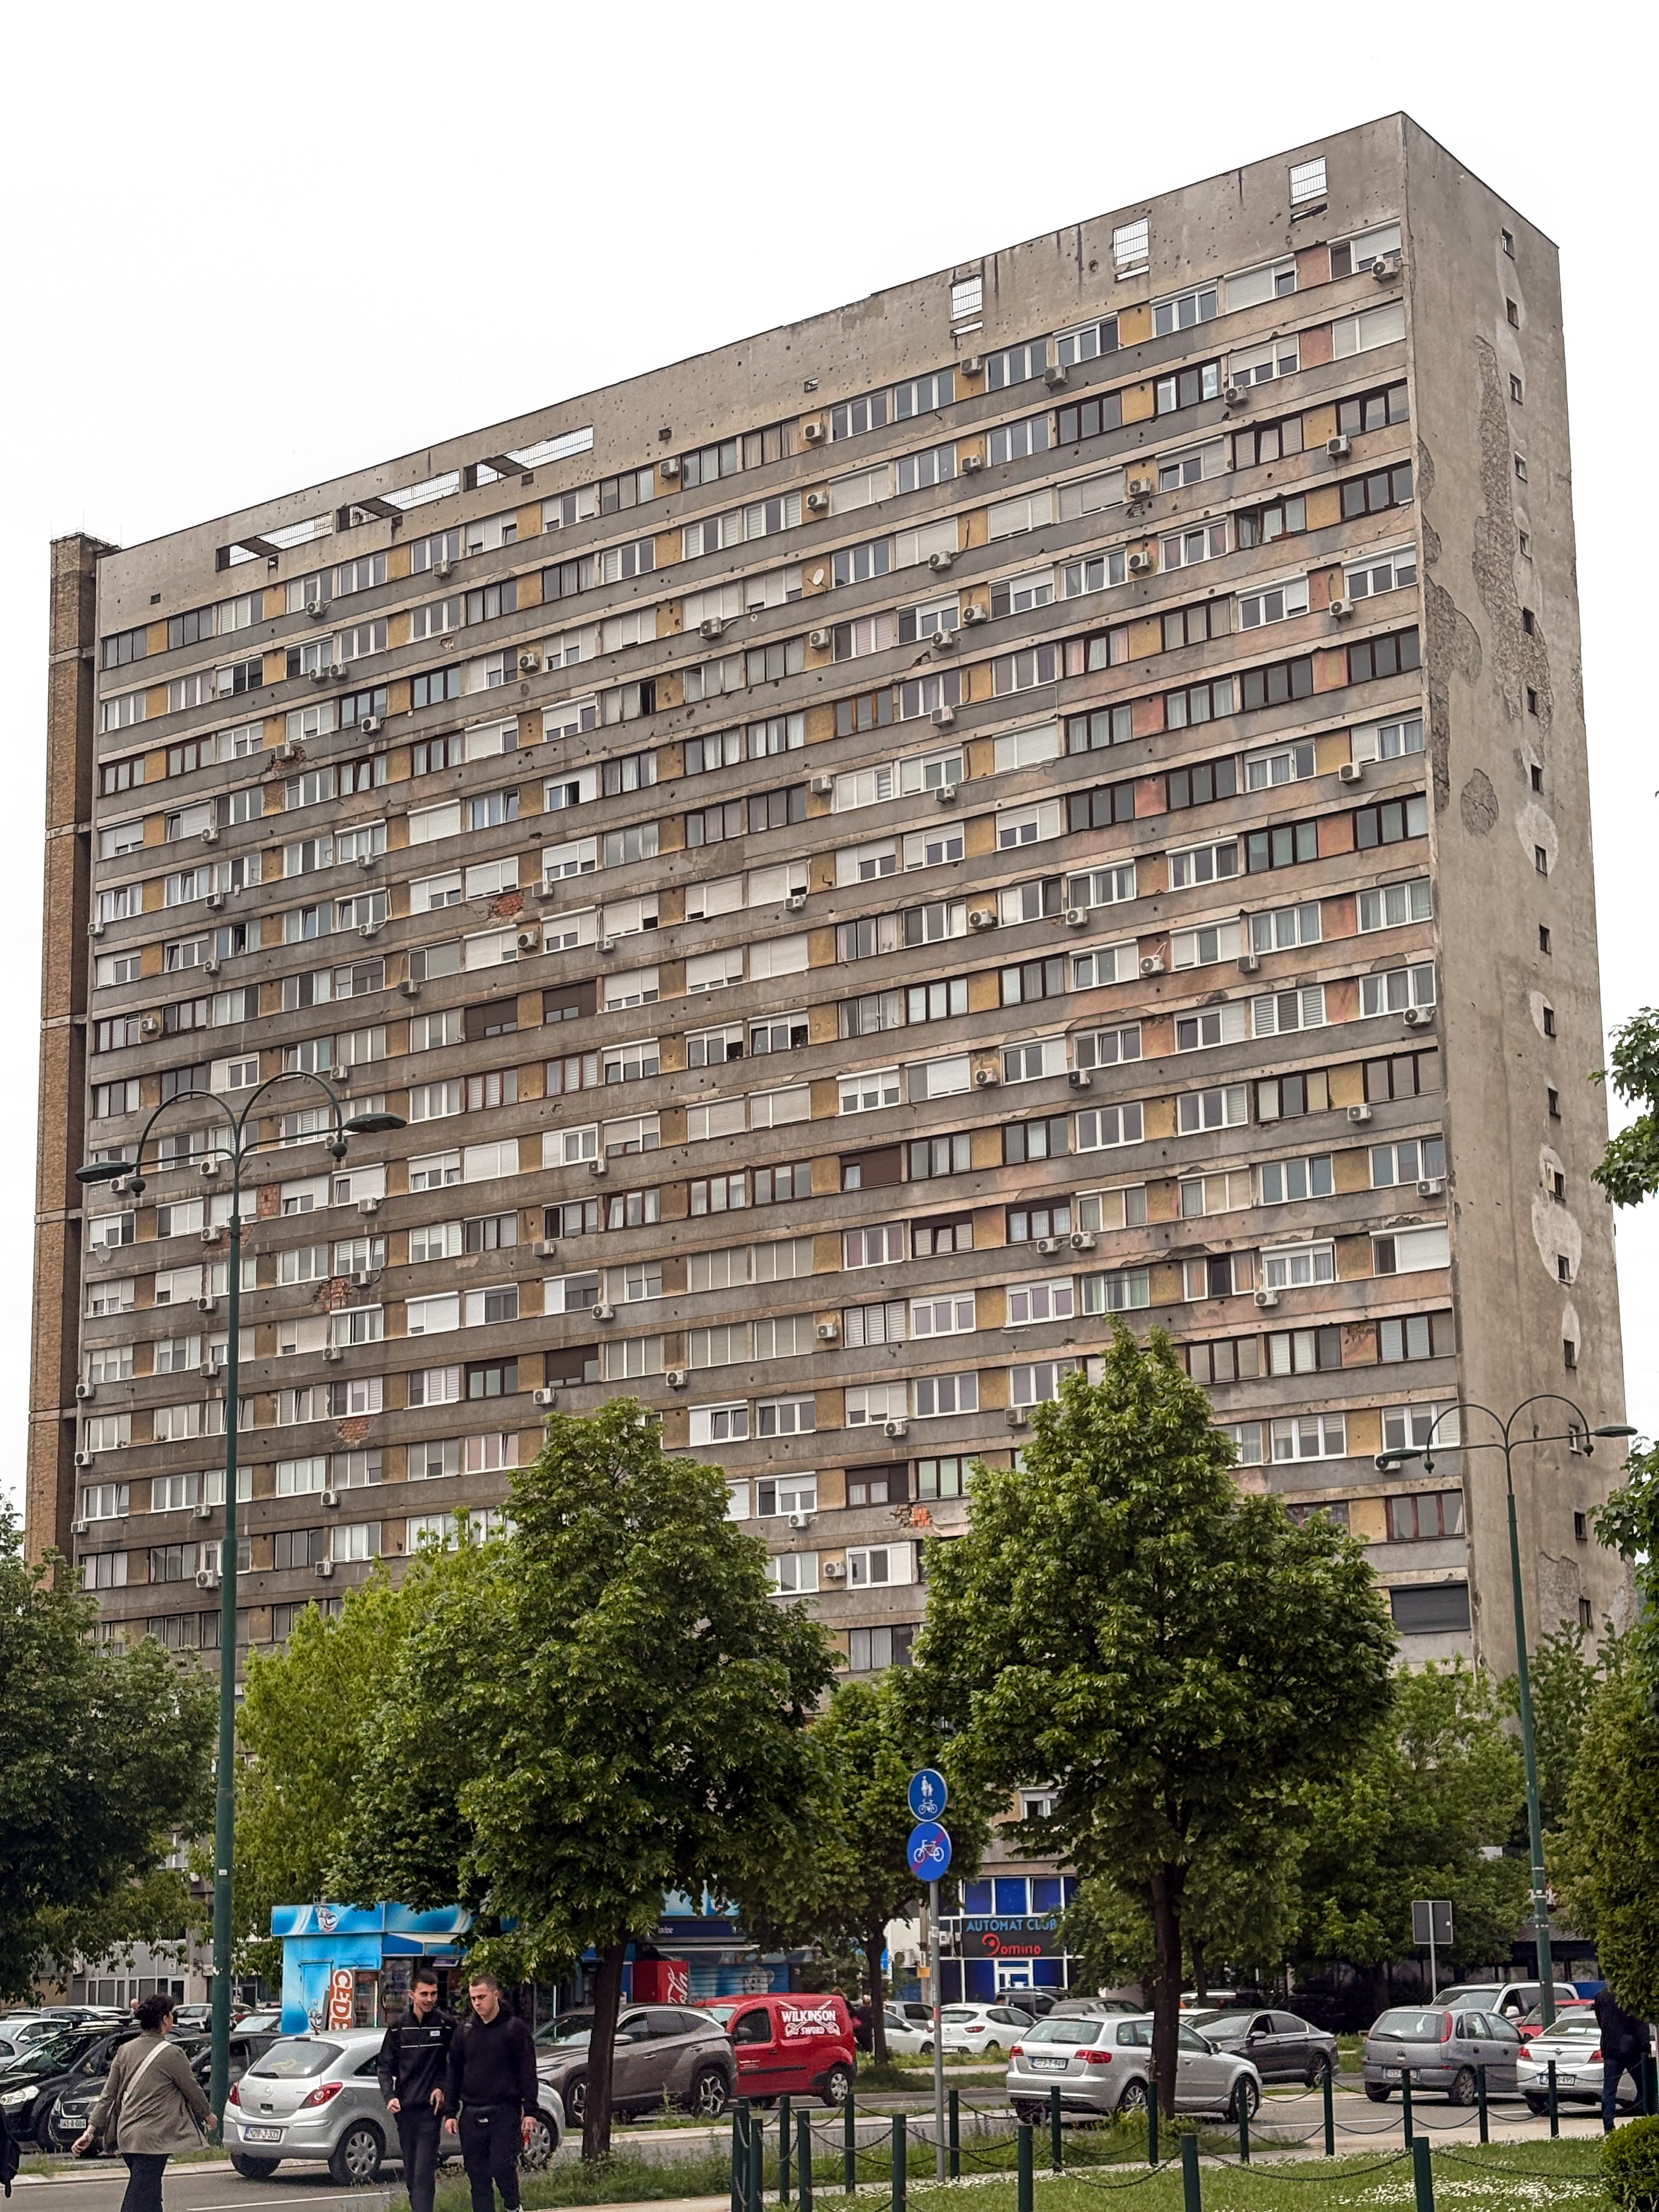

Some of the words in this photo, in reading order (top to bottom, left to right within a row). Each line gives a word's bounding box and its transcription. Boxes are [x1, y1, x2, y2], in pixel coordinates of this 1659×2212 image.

[966, 1919, 1023, 1932] AUTOMAT
[1027, 1919, 1058, 1931] CLUB
[982, 1932, 1042, 1956] Domino
[781, 2010, 836, 2022] WILKINSON
[800, 2027, 825, 2035] SWORD
